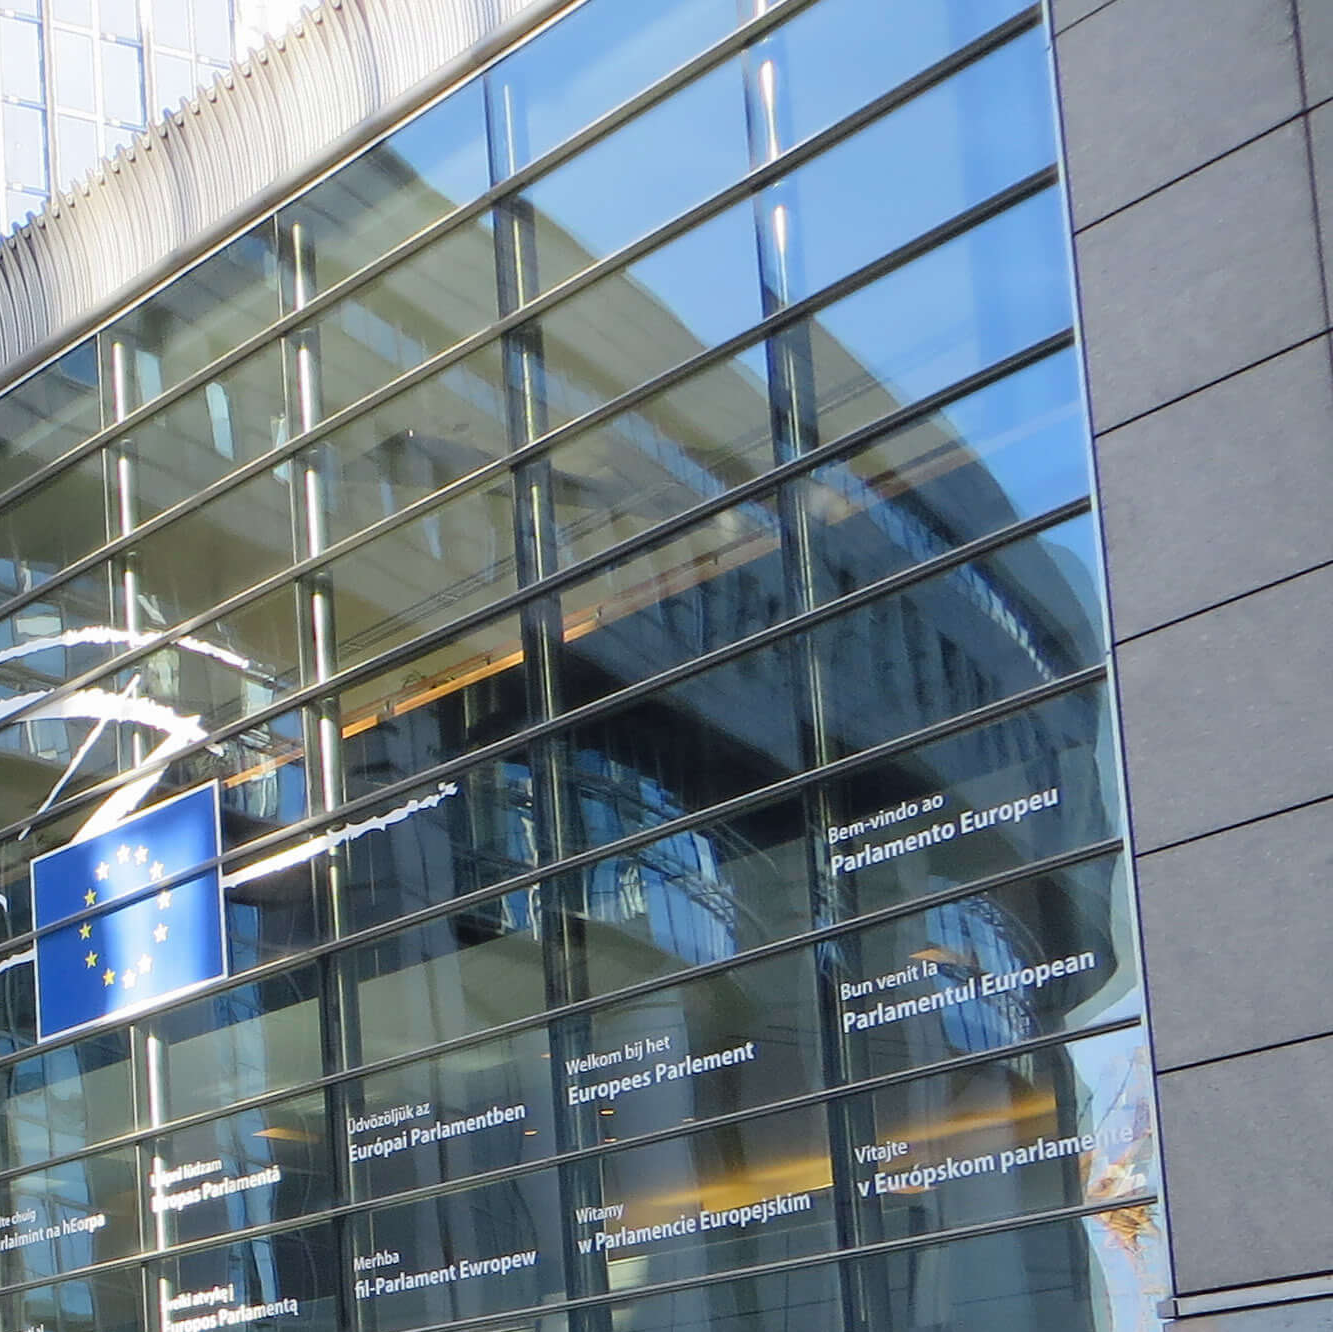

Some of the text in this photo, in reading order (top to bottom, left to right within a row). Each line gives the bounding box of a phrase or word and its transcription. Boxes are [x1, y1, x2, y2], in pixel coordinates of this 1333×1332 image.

[828, 794, 944, 844] Bem-vindo ao
[831, 788, 1060, 876] Parlamento Europeu
[840, 960, 938, 1000] Bun venit la
[843, 951, 1095, 1033] Parlamentul European
[565, 1036, 671, 1076] Welkom bij het
[568, 1041, 755, 1106] Europees Parlement
[416, 1103, 431, 1117] az
[349, 1104, 526, 1163] Európai Parlamentben
[201, 1165, 281, 1200] Parlamentā
[857, 1181, 871, 1198] v
[874, 1155, 995, 1195] Európskom
[46, 1225, 61, 1240] na
[62, 1213, 106, 1235] hEorpa
[575, 1203, 624, 1225] Witamy
[577, 1193, 811, 1255] w Parlamencie Europejskim
[354, 1250, 537, 1299] fil-Parlament Ewropew
[218, 1298, 299, 1326] Parlamentą
